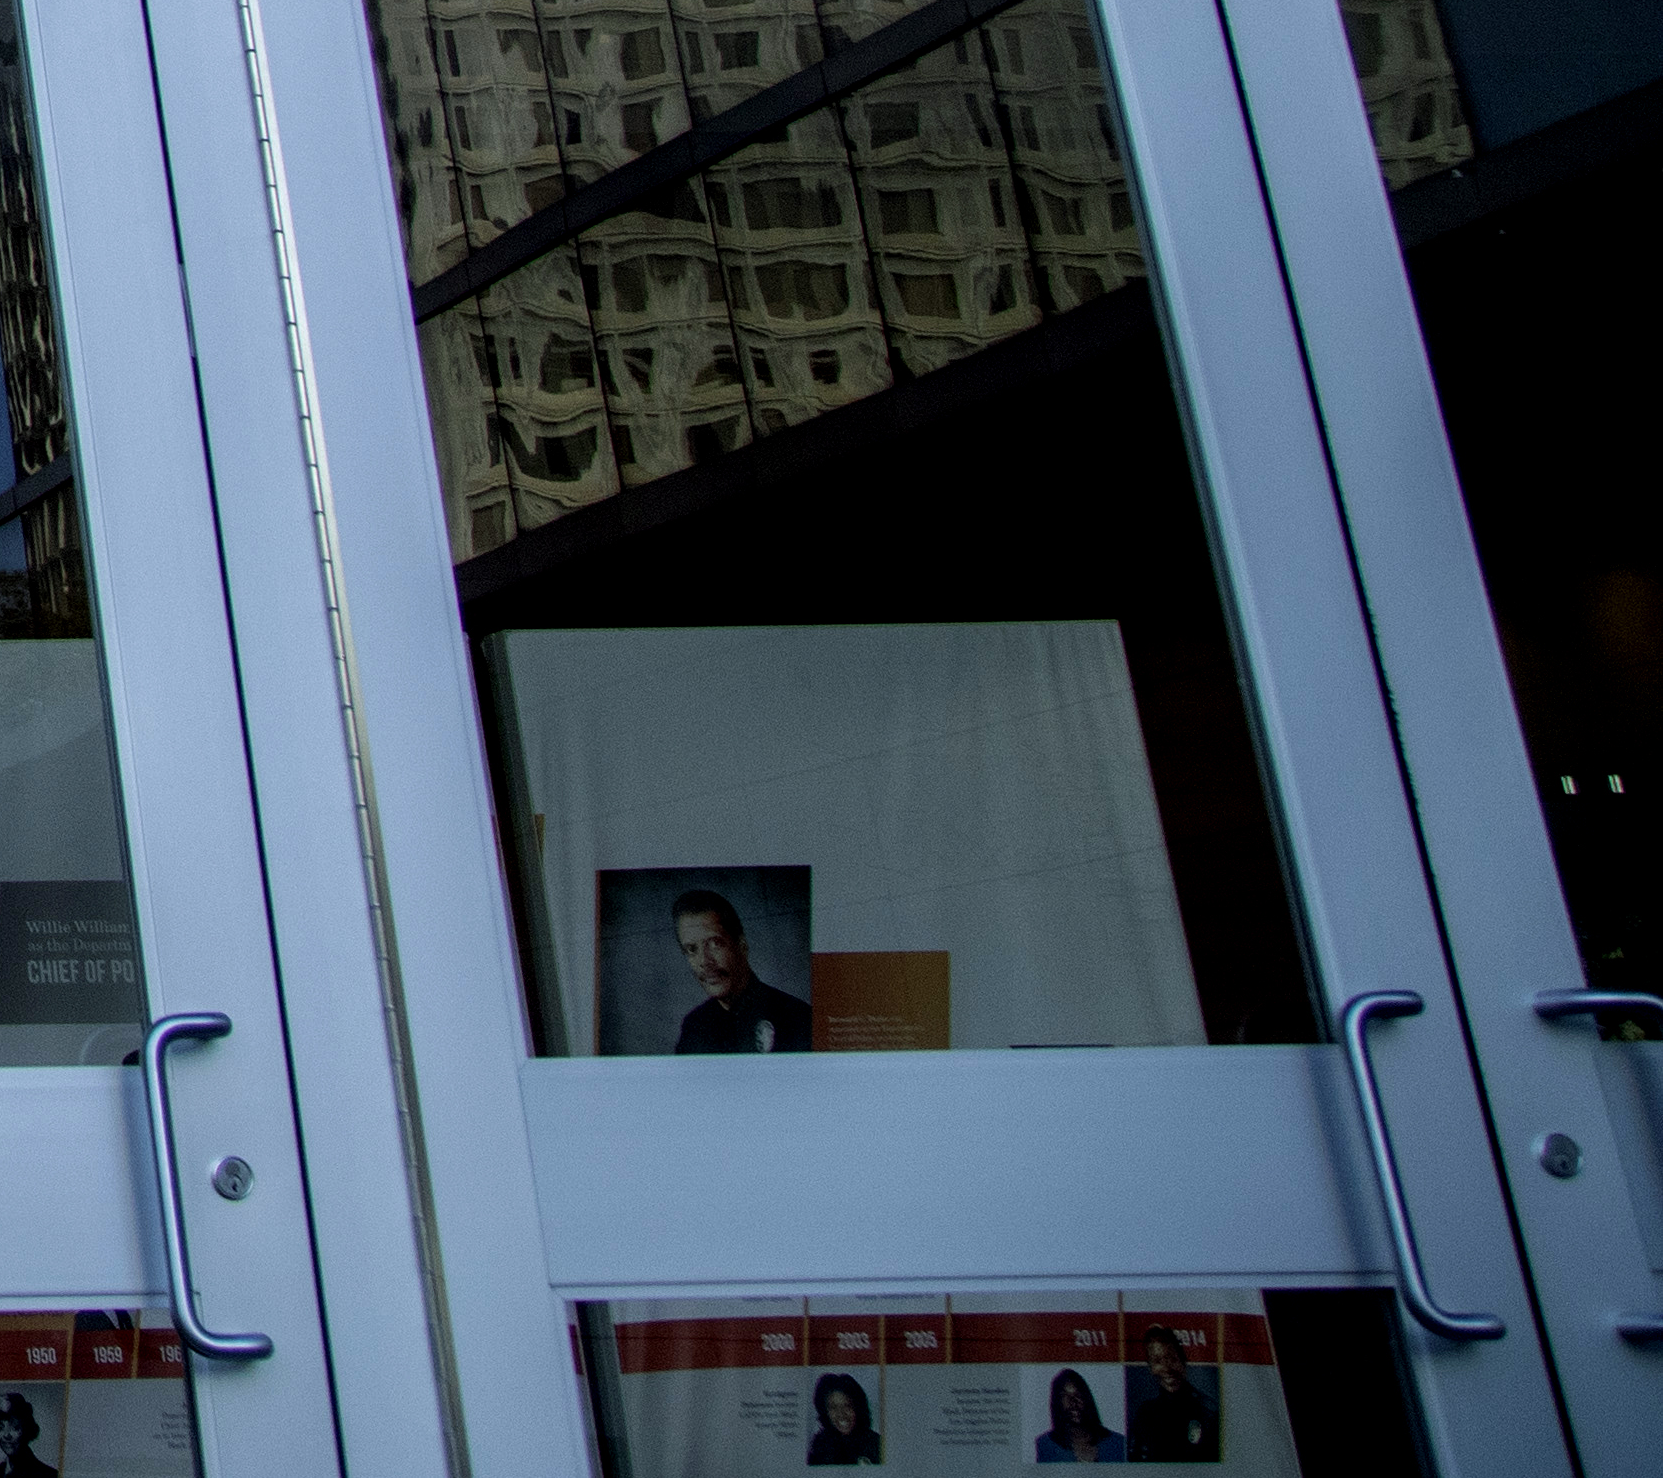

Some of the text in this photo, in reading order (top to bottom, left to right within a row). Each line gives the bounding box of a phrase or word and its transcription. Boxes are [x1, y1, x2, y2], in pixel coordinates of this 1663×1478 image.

[26, 920, 132, 934] Willie William
[46, 938, 69, 952] the
[27, 959, 136, 984] CHIEF OF PO
[1073, 1329, 1107, 1347] 2011
[25, 1347, 57, 1365] 1950
[94, 1346, 123, 1364] 1959
[160, 1346, 183, 1363] 196
